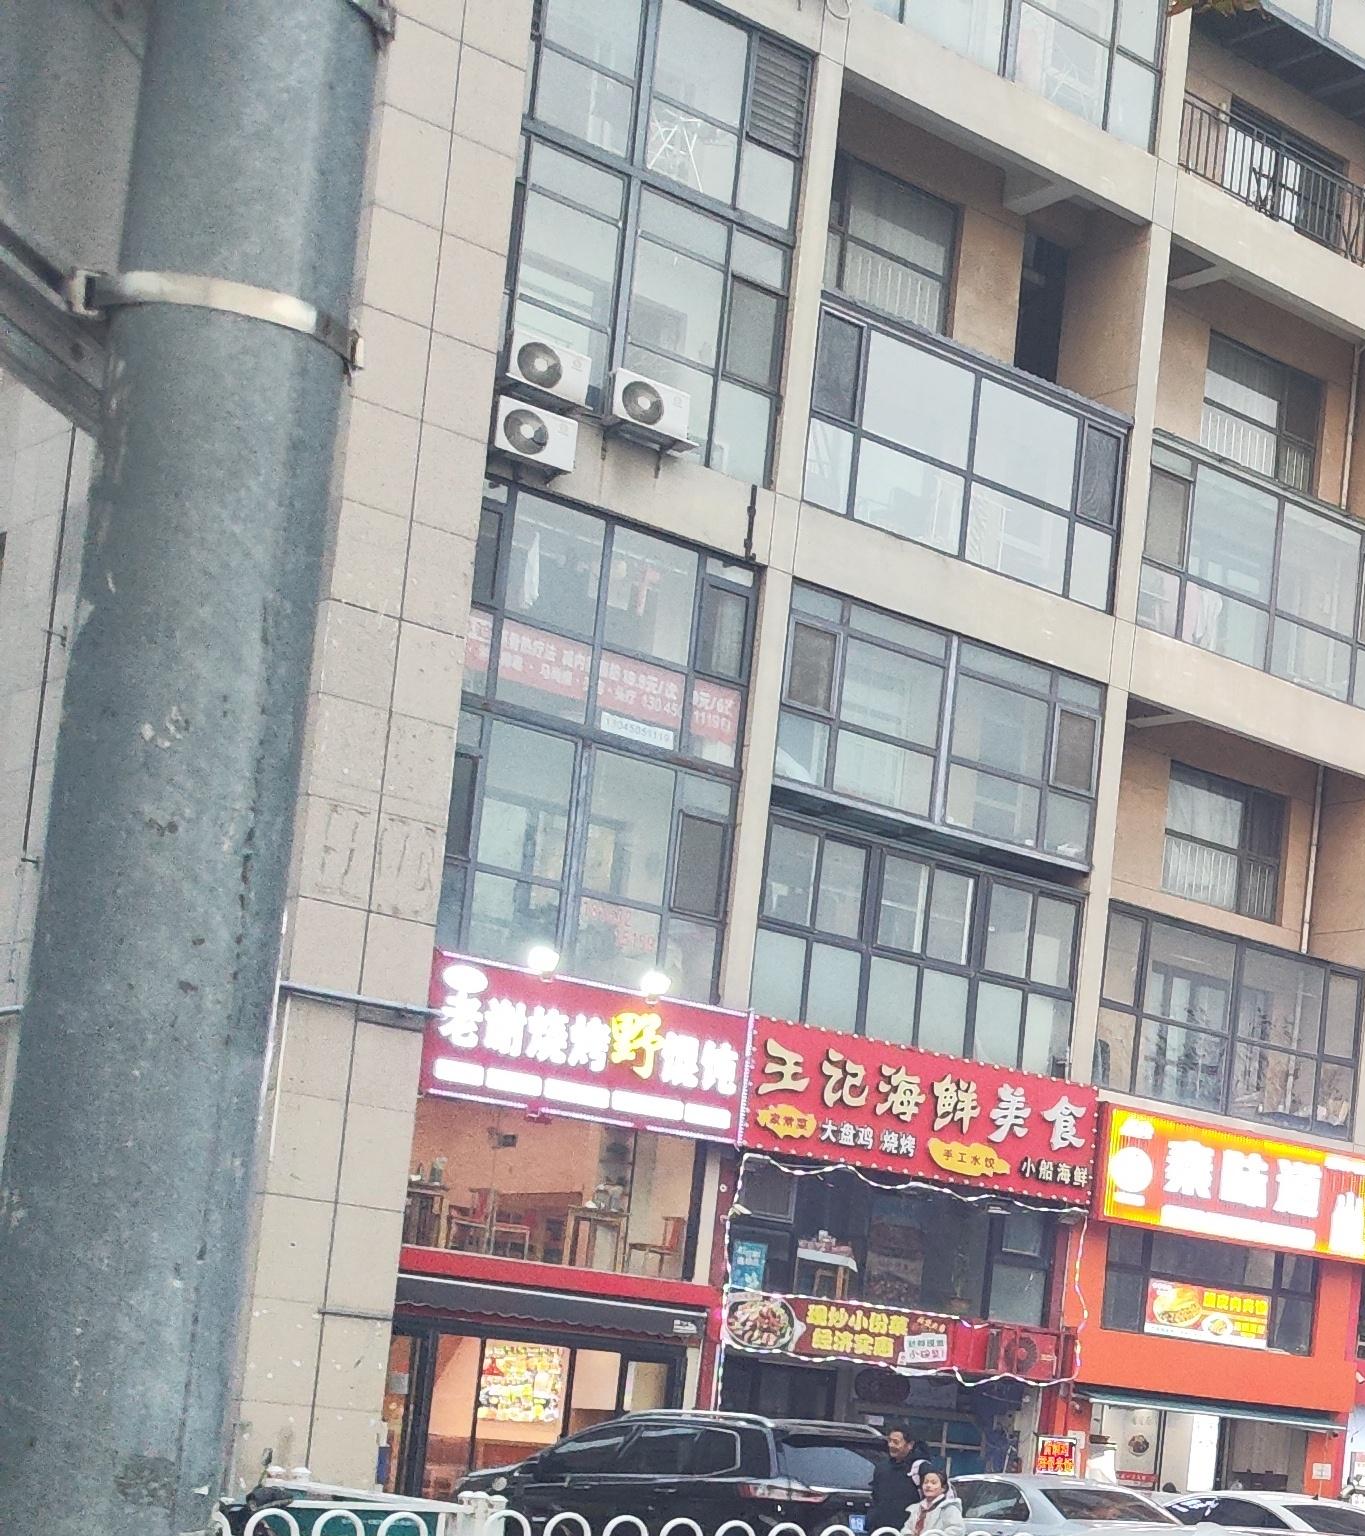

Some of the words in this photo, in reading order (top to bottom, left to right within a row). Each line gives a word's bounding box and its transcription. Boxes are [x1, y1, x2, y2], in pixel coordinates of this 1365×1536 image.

[757, 1037, 1087, 1151] 王记海鲜美食
[819, 1117, 874, 1150] 大盘鸡
[879, 1131, 916, 1157] 烧烤
[943, 1147, 996, 1170] 手工水饺
[1021, 1156, 1088, 1187] 小船海鲜
